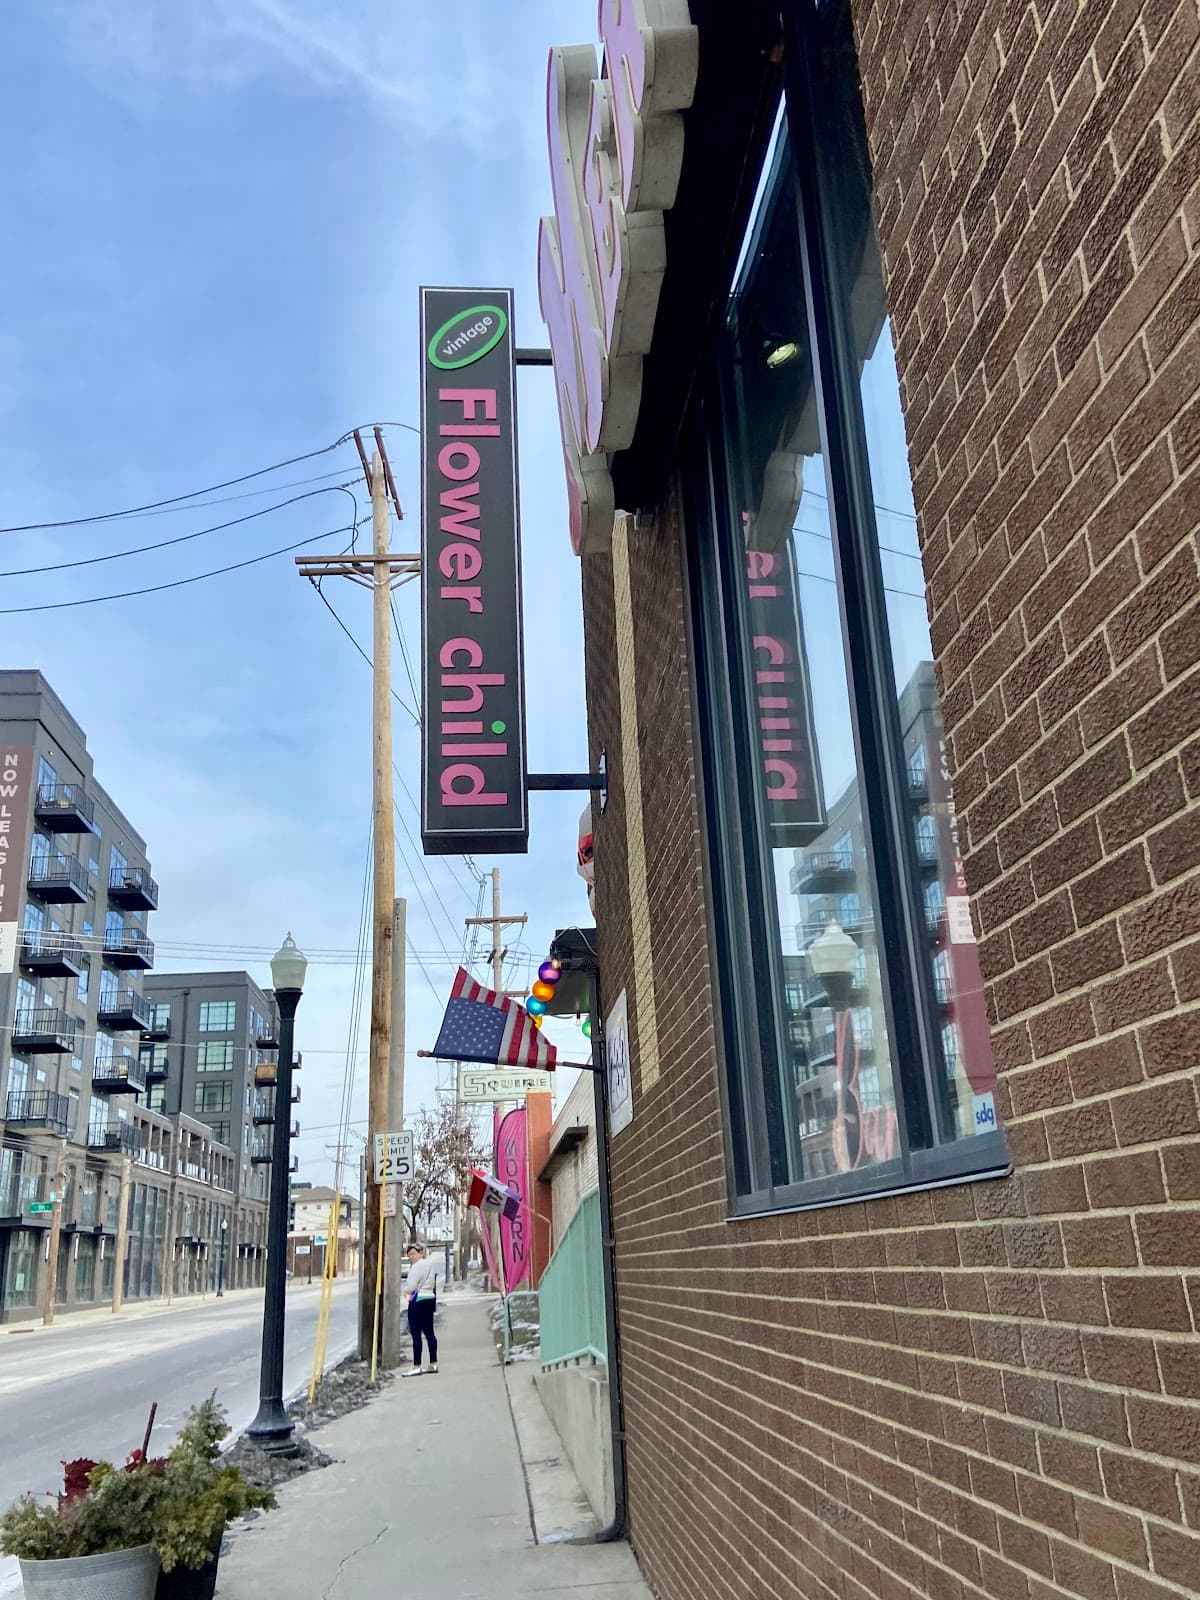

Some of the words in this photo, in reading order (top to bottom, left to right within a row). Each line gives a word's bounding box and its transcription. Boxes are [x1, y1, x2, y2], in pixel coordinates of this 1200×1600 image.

[442, 316, 493, 356] vintage
[438, 388, 500, 614] Flower
[439, 637, 508, 806] child
[0, 754, 18, 798] NOW
[0, 805, 11, 913] LEASI
[377, 1136, 410, 1146] SPEED
[381, 1147, 407, 1156] LIMIT
[379, 1157, 410, 1177] 25
[503, 1139, 524, 1263] MODRN
